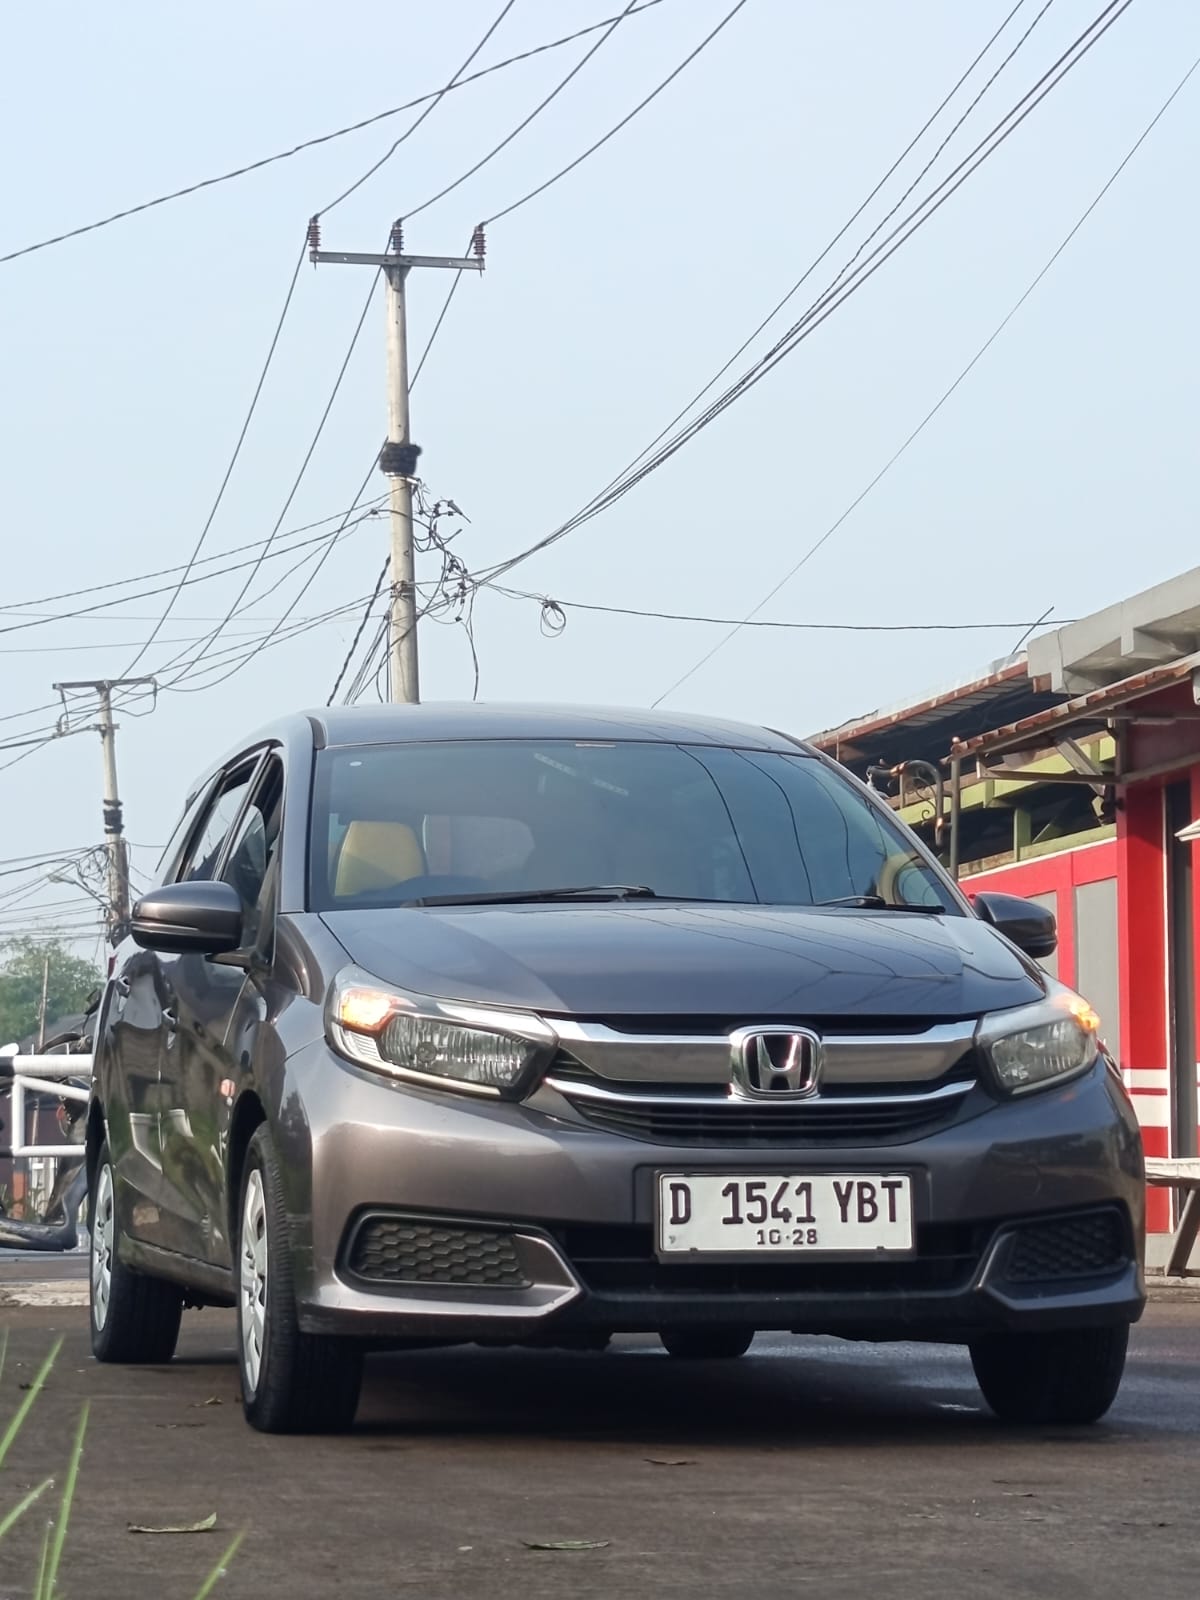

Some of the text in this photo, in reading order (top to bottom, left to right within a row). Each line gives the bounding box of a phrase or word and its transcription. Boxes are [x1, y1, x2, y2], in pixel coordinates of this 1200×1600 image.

[669, 1180, 903, 1225] D 1541 YBT
